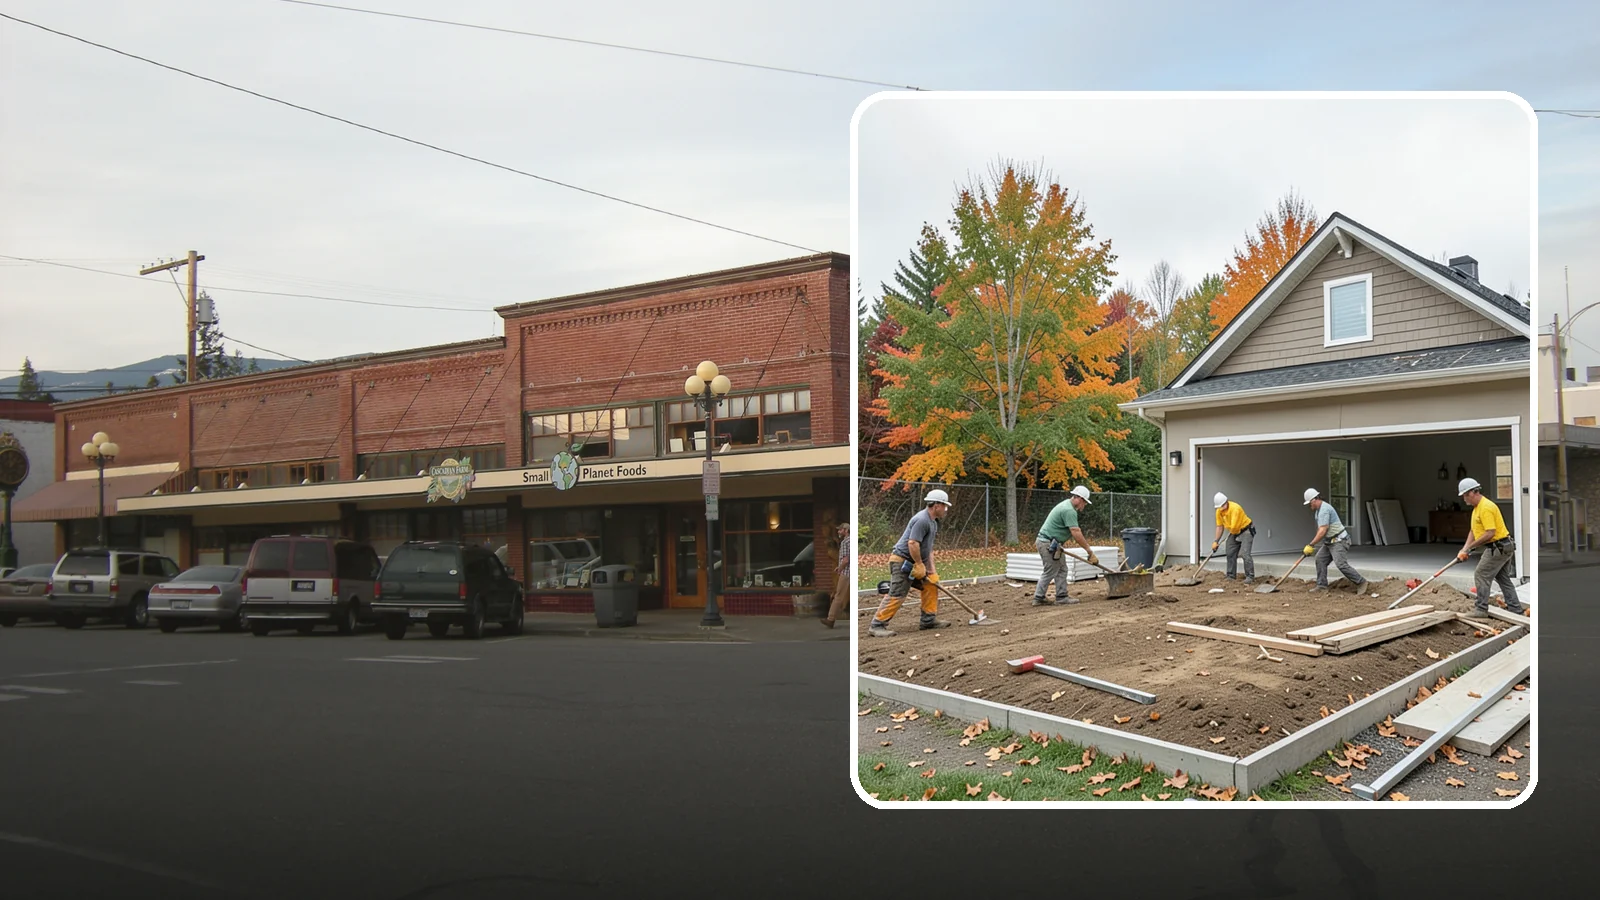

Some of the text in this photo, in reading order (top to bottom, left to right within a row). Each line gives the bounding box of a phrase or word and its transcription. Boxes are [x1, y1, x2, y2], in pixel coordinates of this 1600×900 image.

[523, 465, 646, 482] Small Planet Foods
